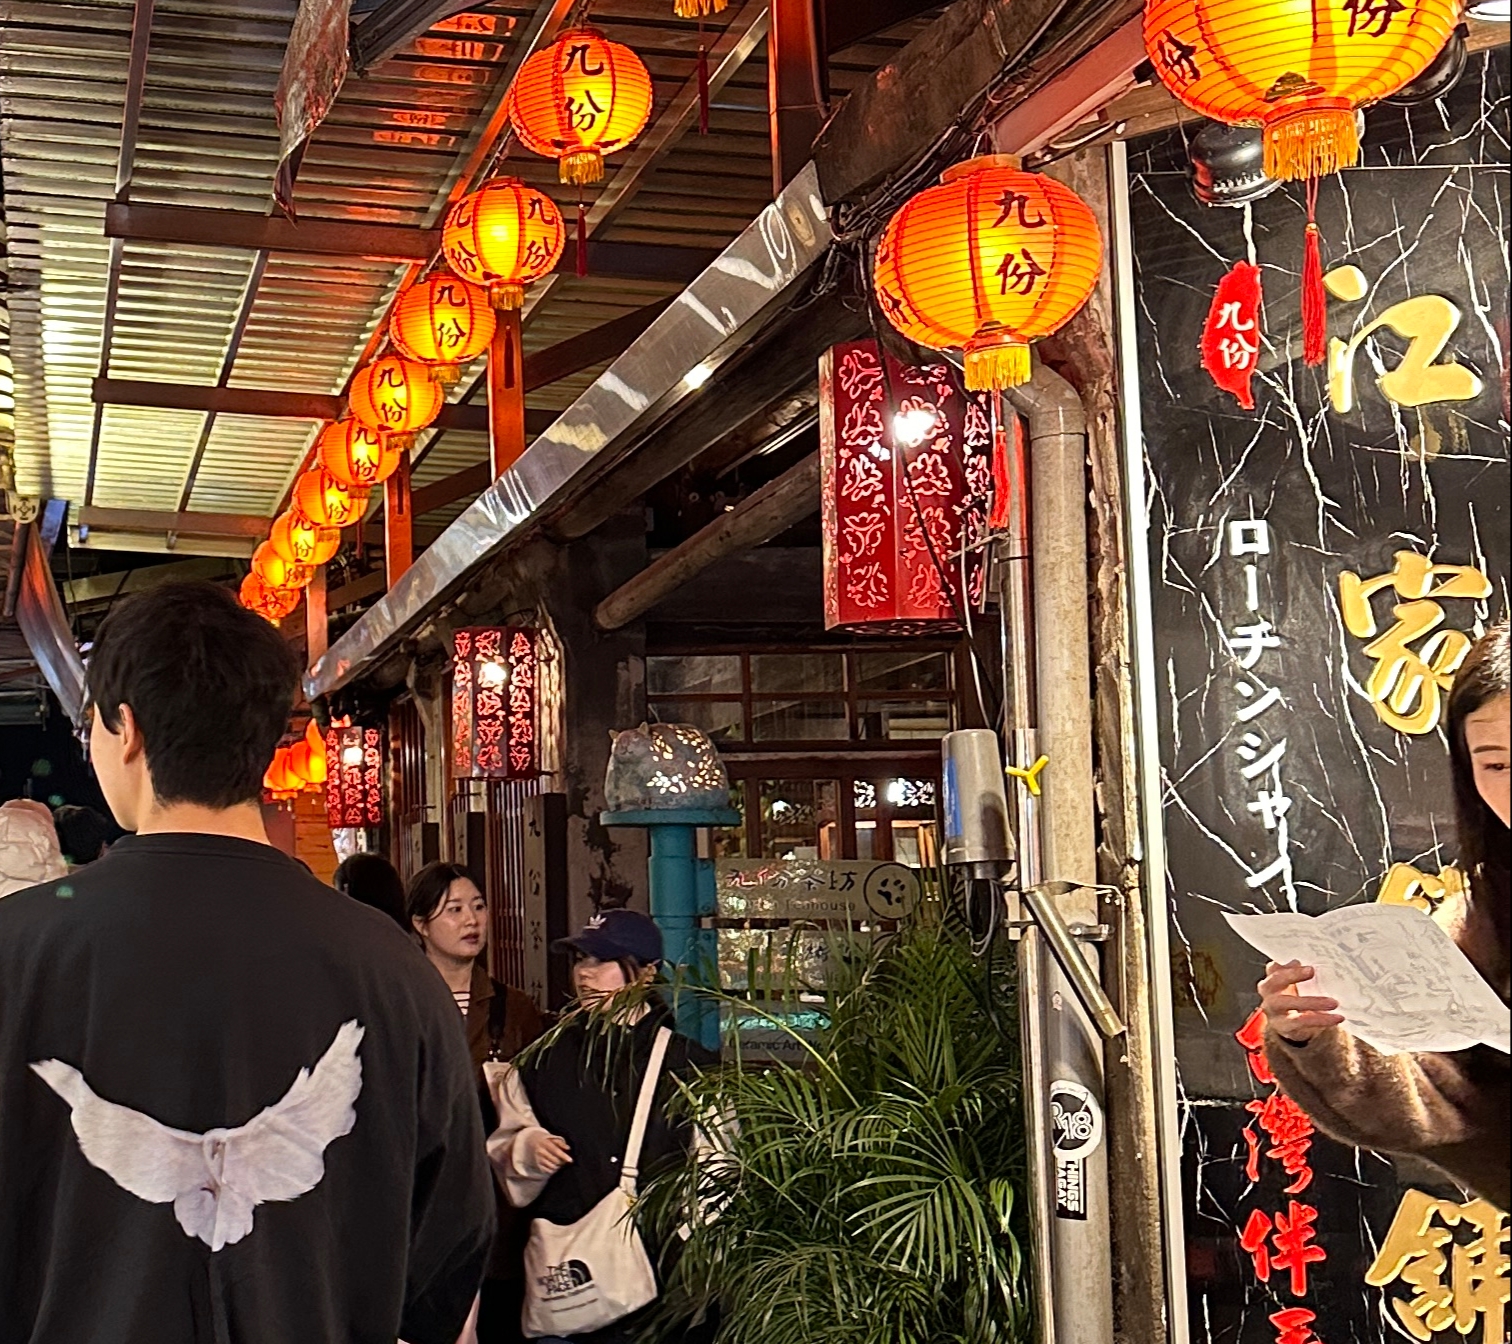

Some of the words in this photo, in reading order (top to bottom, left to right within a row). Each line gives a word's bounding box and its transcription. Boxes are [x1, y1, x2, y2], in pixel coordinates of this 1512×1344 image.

[561, 44, 605, 133] 九份
[450, 200, 482, 273] 九份
[525, 197, 556, 270] 九份
[992, 190, 1047, 296] 九份
[436, 284, 467, 349] 九份
[1216, 300, 1258, 372] 九份
[377, 366, 408, 424] 九份
[354, 425, 378, 481] 九份
